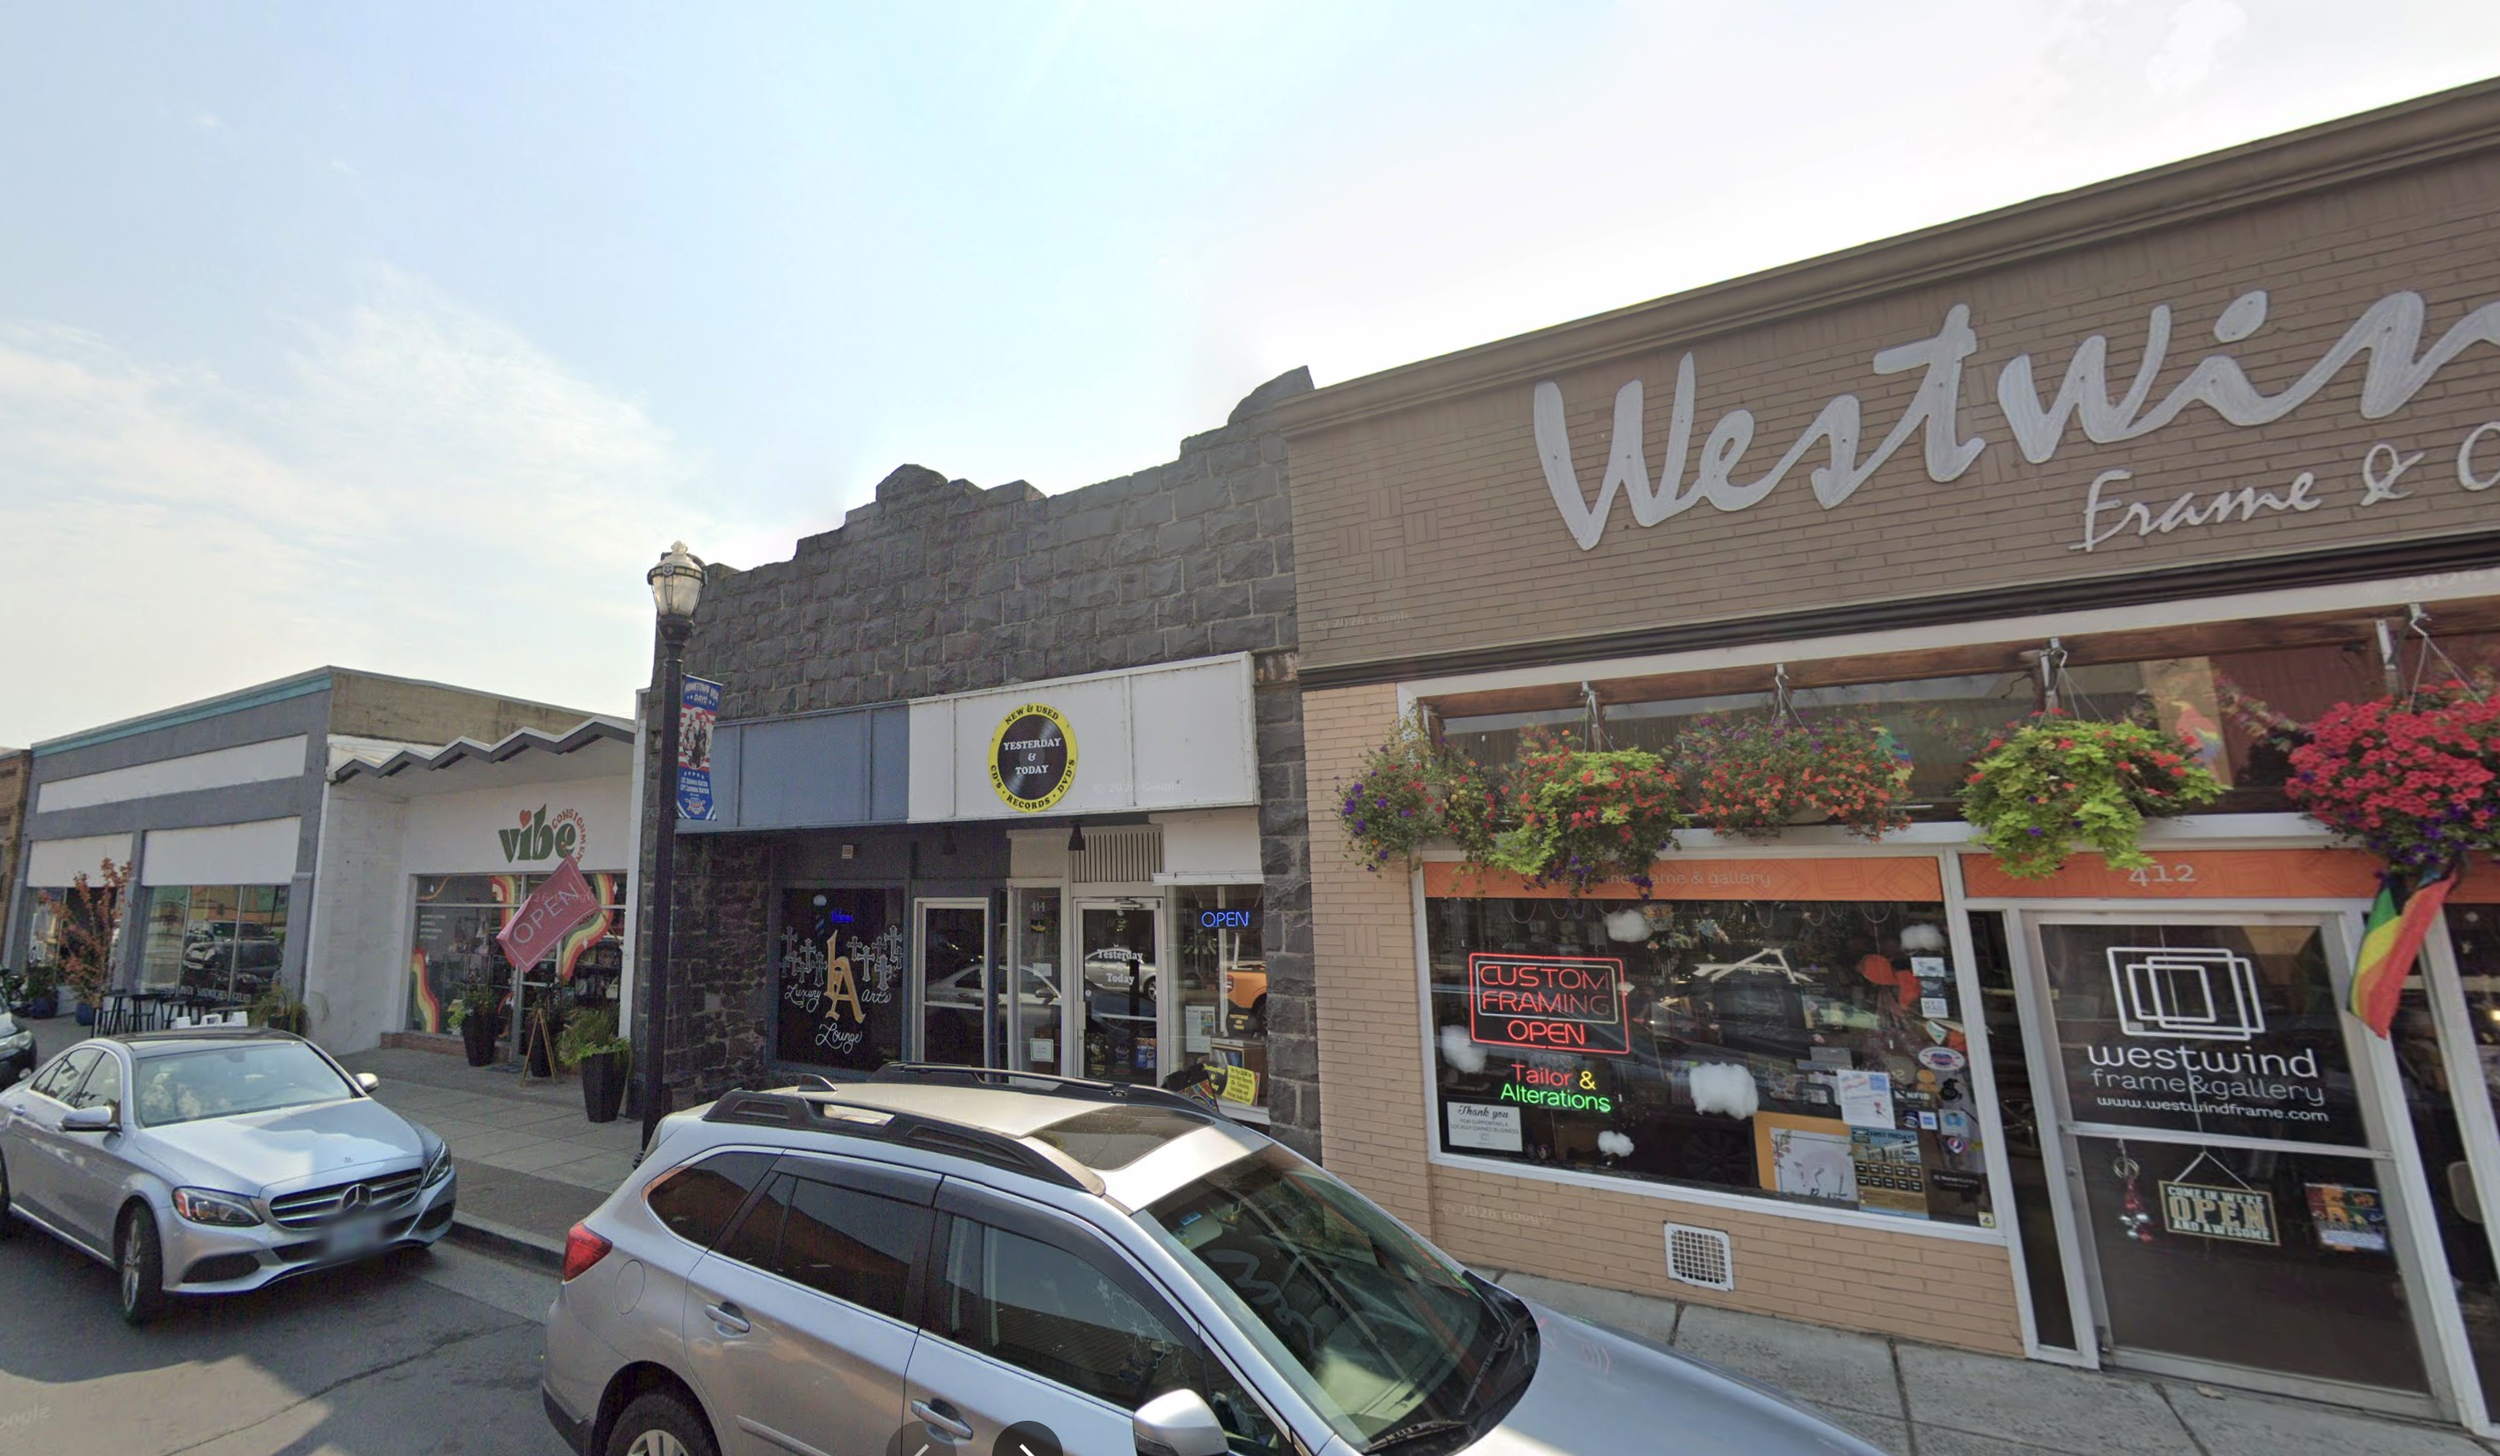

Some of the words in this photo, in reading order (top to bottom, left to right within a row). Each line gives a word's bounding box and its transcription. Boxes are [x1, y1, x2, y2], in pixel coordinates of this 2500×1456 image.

[2068, 469, 2323, 552] Frame
[2360, 443, 2426, 506] &
[1004, 708, 1024, 725] NEW
[1026, 704, 1034, 713] &
[1036, 705, 1059, 720] USED
[1003, 738, 1061, 751] YESTERDAY
[1027, 753, 1036, 761] &
[1015, 765, 1049, 775] TODAY
[990, 765, 1003, 789] CD'S
[1006, 794, 1051, 810] RECORDS
[1057, 759, 1075, 793] DVD'S
[498, 804, 576, 863] vibe
[1690, 870, 1704, 884] &
[1708, 869, 1772, 888] gallery
[2128, 863, 2197, 887] 412
[512, 881, 579, 944] OPEN
[1201, 911, 1250, 928] OPEN
[1097, 948, 1144, 961] Yesterday
[1105, 973, 1135, 985] Today
[1480, 965, 1610, 991] CUSTOM
[784, 984, 822, 1013] Luxury
[1481, 990, 1610, 1015] FRAMING
[815, 1022, 863, 1054] Lounge
[1507, 1019, 1586, 1046] OPEN
[2087, 1046, 2319, 1078] westwind
[1511, 1064, 1573, 1087] Tailor
[1579, 1070, 1596, 1090] &
[2091, 1068, 2325, 1107] frame&gallery
[1500, 1083, 1611, 1112] Alterations
[2097, 1097, 2330, 1122] www.westwindframe.com
[1458, 1105, 1489, 1117] Thank
[1492, 1110, 1509, 1119] you
[1471, 1119, 1504, 1127] SUPPORTING
[1887, 1131, 1917, 1141] FRIDAYS
[2167, 1186, 2202, 1199] COME
[2204, 1189, 2218, 1199] IN
[2168, 1196, 2268, 1230] OPEN
[2173, 1220, 2200, 1231] AND
[2203, 1223, 2271, 1240] AWESOME
